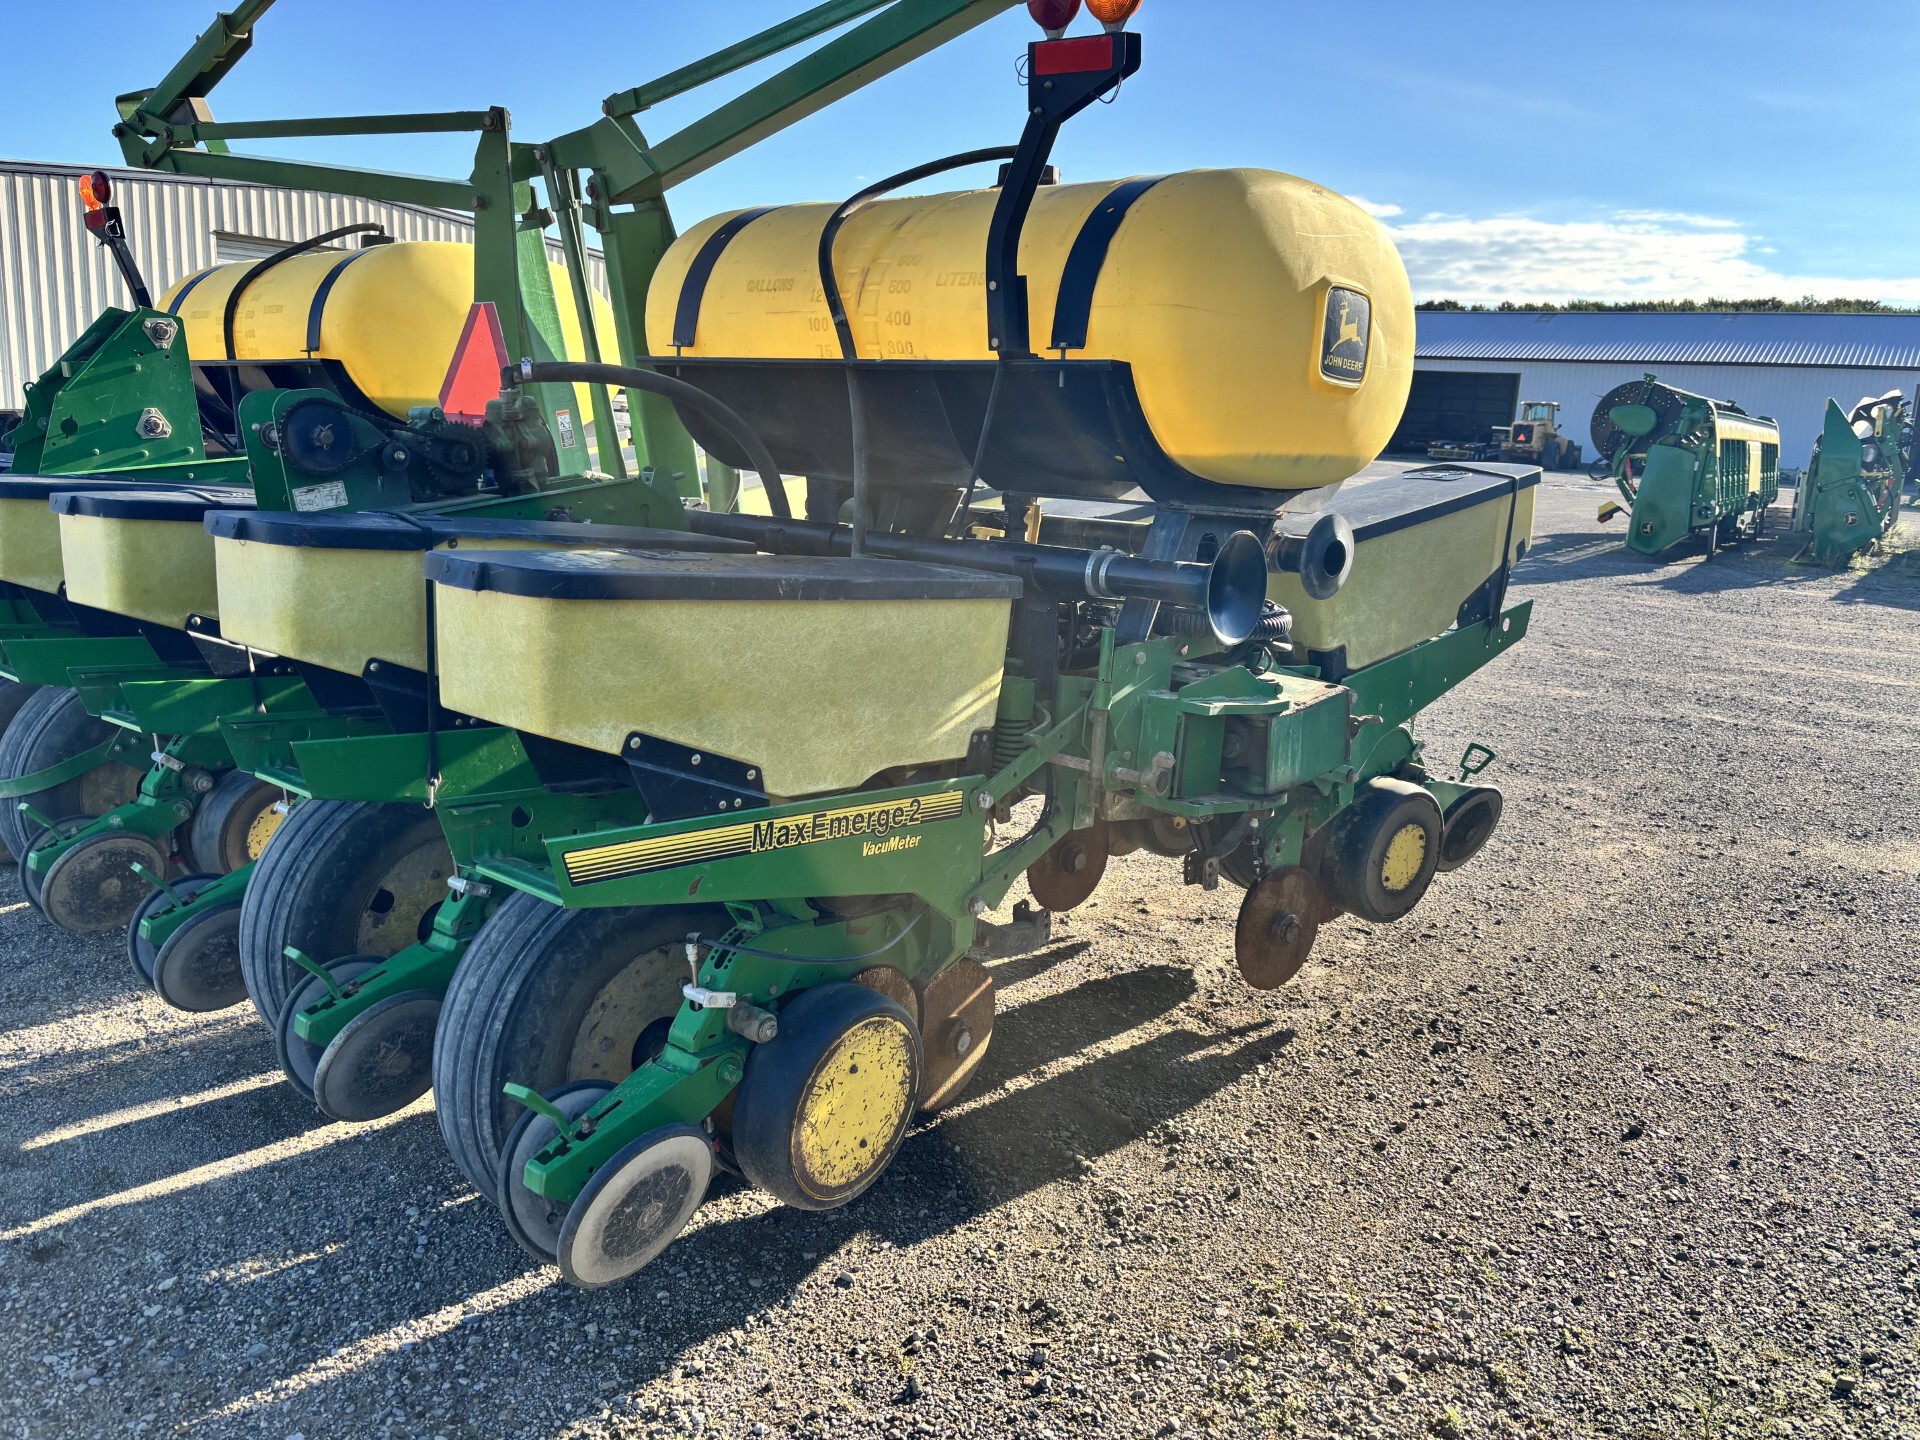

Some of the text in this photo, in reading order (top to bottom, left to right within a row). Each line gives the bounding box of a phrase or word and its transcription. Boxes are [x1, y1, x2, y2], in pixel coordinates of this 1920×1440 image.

[746, 278, 795, 293] GALLONS
[810, 288, 827, 303] 12
[808, 316, 829, 332] 100
[884, 311, 911, 326] 400
[816, 344, 833, 358] 75
[888, 340, 913, 355] 300
[1324, 354, 1363, 372] JOHN DEERE
[751, 798, 923, 852] MaxEmerge 2
[862, 834, 922, 857] VacuMeter
